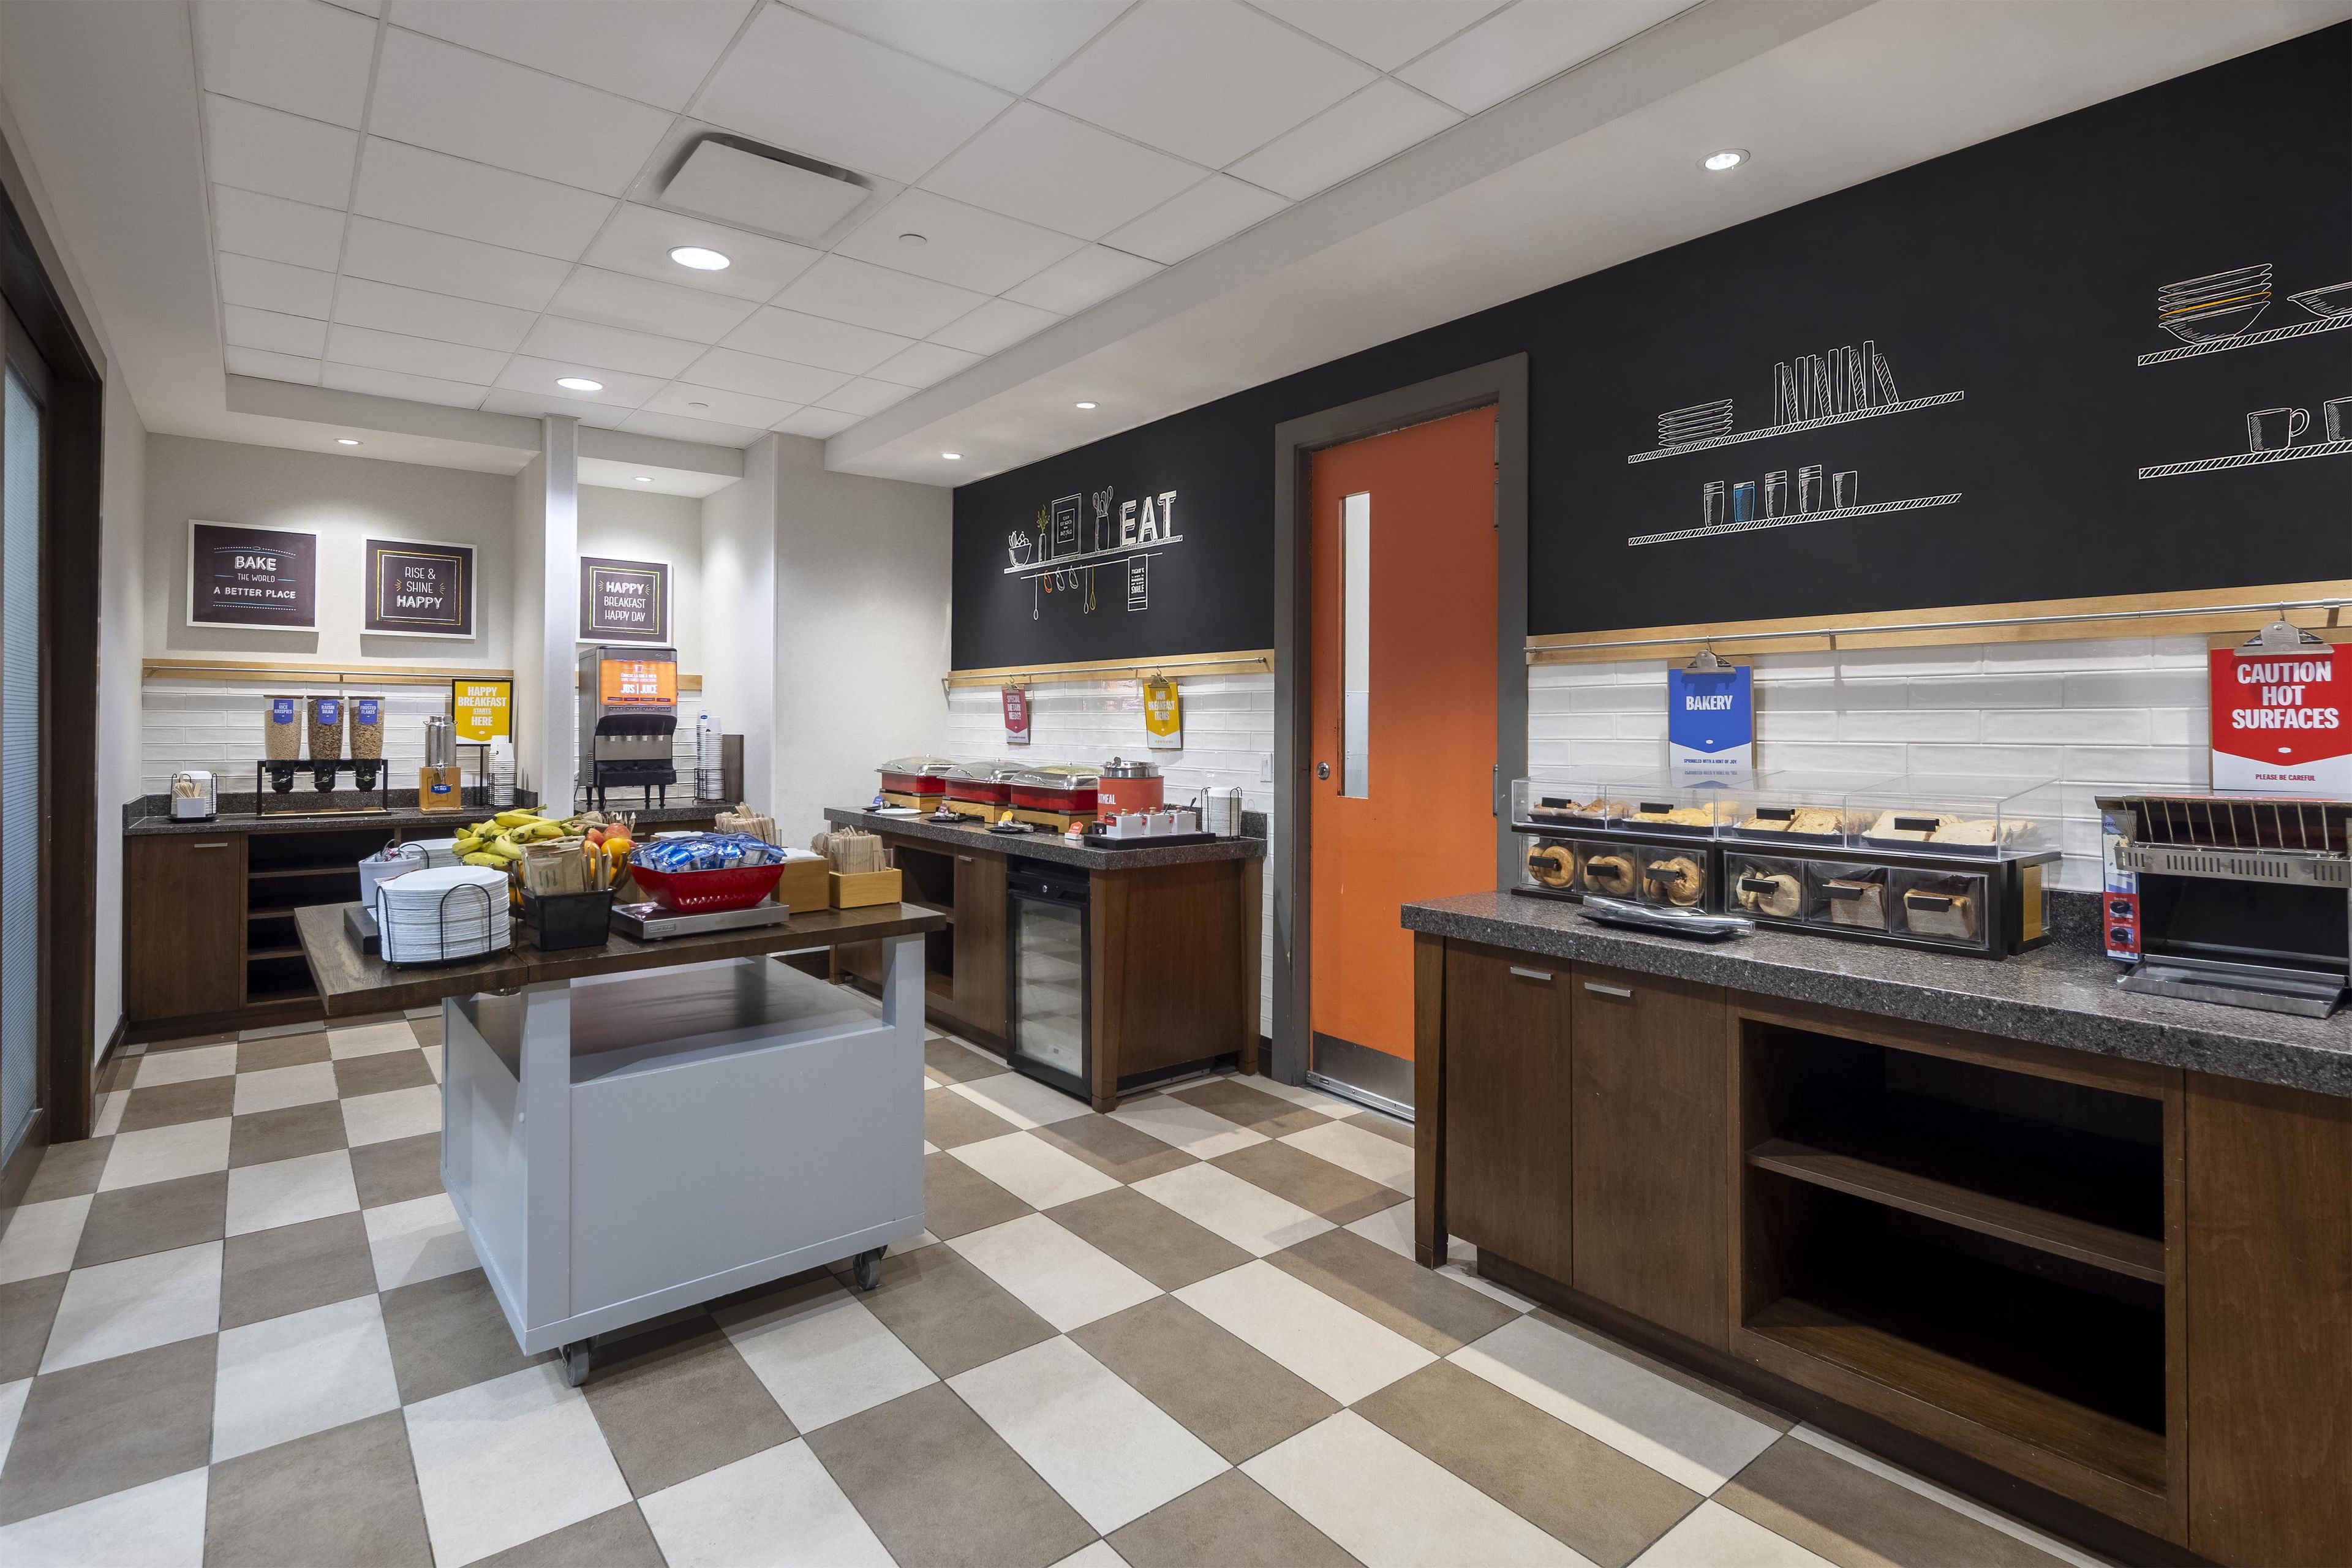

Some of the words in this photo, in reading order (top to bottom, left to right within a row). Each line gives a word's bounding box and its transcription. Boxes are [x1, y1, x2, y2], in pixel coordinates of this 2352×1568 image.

[1119, 490, 1177, 547] EAT
[235, 556, 276, 571] BAKE
[405, 567, 425, 579] RISE
[428, 568, 435, 579] &
[225, 587, 262, 597] BETTER
[266, 590, 296, 599] PLACE
[406, 581, 433, 594] SHINE
[606, 581, 644, 595] HAPPY
[396, 595, 443, 609] HAPPY
[604, 596, 646, 608] BREAKFAST
[605, 609, 630, 621] HAPPY
[631, 612, 646, 622] DAY
[2237, 661, 2331, 684] CAUTION
[467, 687, 497, 696] HAPPY
[620, 684, 635, 693] JUS
[640, 684, 658, 694] JUICE
[458, 696, 507, 706] BREAKFAST
[1155, 691, 1166, 700] HOT
[2262, 685, 2305, 706] HOT
[1148, 701, 1175, 710] BREAKFAST
[1686, 695, 1733, 710] BAKERY
[471, 717, 493, 726] HERE
[1155, 711, 1170, 720] ITEMS
[2232, 707, 2339, 729] SURFACES
